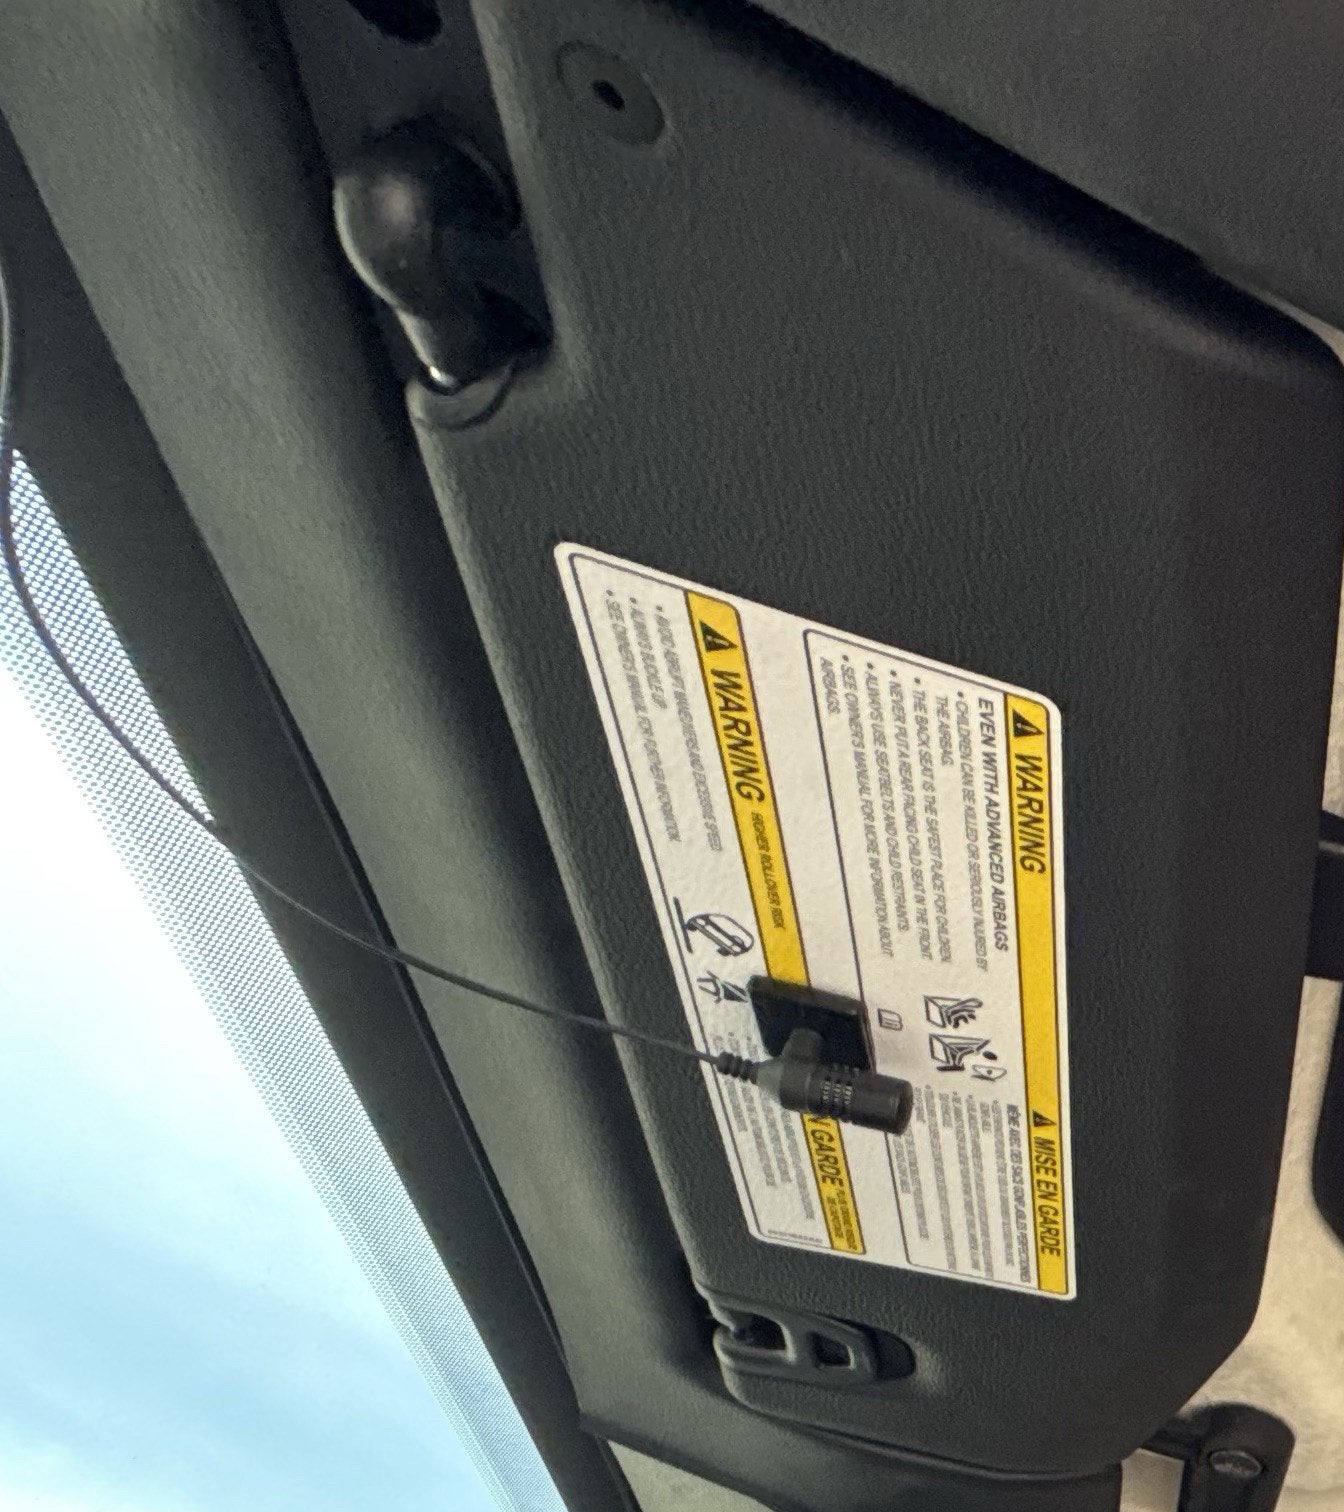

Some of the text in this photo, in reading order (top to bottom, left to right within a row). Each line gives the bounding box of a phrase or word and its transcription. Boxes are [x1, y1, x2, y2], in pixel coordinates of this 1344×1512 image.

[911, 686, 927, 715] THE
[708, 663, 767, 806] WARNING
[914, 713, 931, 750] BACK
[917, 748, 934, 781] SEAT
[921, 779, 935, 794] IS
[922, 792, 938, 818] THE
[976, 696, 1009, 953] EVEN WITH ADVANCED AIRBAGS
[1013, 748, 1046, 877] WARNING
[925, 816, 942, 860] SAFEST
[954, 698, 988, 973] CHILDREN CAN BE KILLED OR SERIOUSLY INJURED BY
[929, 857, 945, 893] PLACE
[933, 892, 948, 916] FOR
[809, 1127, 844, 1187] GARDE
[1033, 1135, 1061, 1257] MISE EN GARDE
